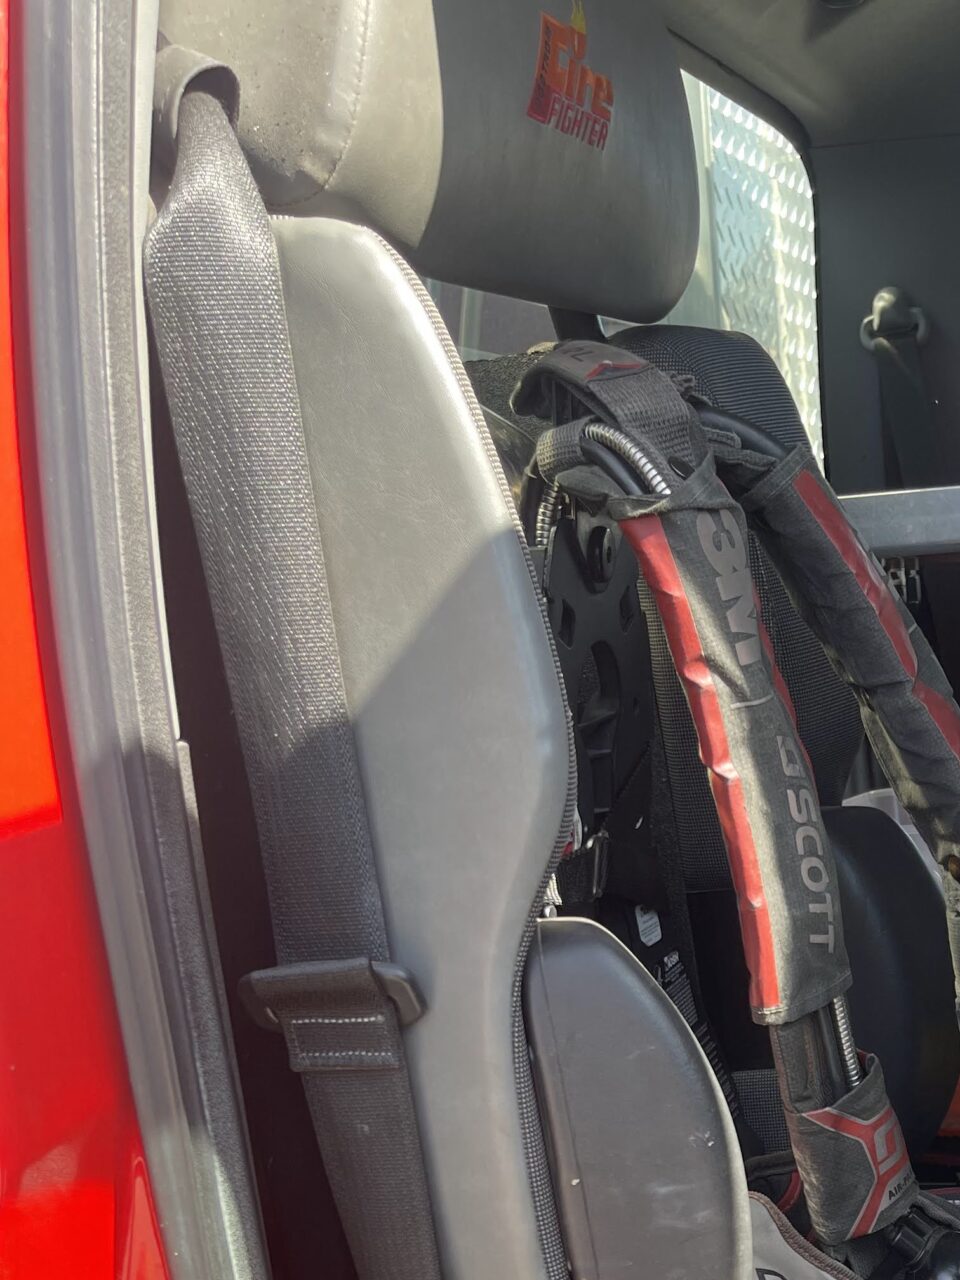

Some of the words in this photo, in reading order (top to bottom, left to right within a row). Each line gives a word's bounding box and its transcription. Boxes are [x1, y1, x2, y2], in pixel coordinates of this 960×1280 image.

[546, 90, 611, 150] FIGHTER
[696, 508, 762, 667] 3M
[786, 788, 836, 954] SCOTT
